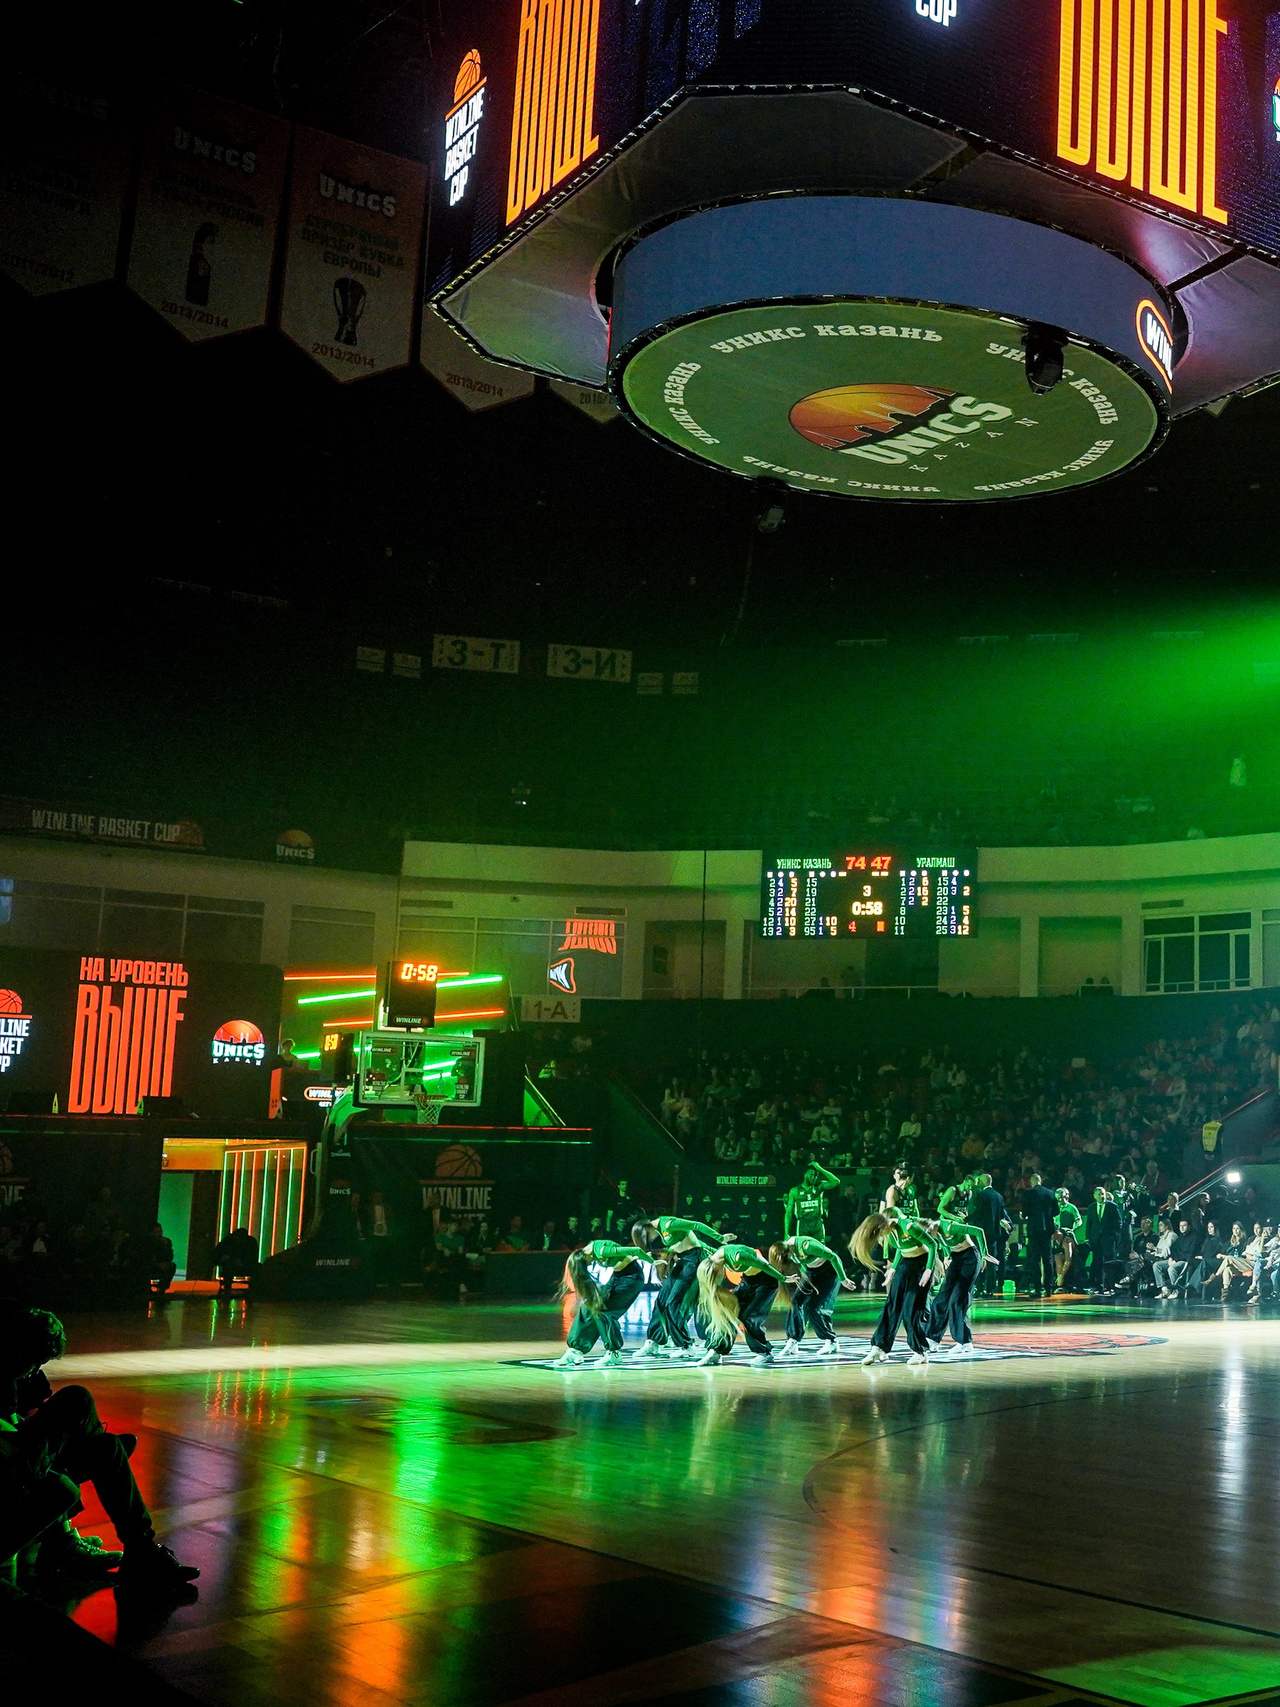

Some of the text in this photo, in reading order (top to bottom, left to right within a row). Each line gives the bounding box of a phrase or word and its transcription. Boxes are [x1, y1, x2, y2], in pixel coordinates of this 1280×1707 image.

[445, 87, 485, 150] WINLINE
[173, 126, 256, 175] UNICS
[444, 123, 479, 181] BASKET
[450, 165, 468, 207] CUP
[318, 173, 396, 219] UNICS
[359, 245, 405, 269] КУБКА
[323, 251, 382, 279] ЕВРОПЫ
[160, 301, 230, 330] 2013/2014
[311, 343, 376, 370] 2013/2014
[445, 373, 504, 399] 2013/2014
[839, 396, 1013, 465] UNICS
[31, 809, 181, 843] WINLINE BASKET CUP
[275, 843, 316, 860] UNICS
[777, 858, 831, 869] УНИКС КАЗАНЬ
[846, 857, 891, 869] 74 47
[916, 857, 955, 868] УРАЛМАШ
[770, 879, 797, 887] 2 4 5
[807, 879, 817, 887] 15
[901, 878, 906, 886] 1
[909, 877, 915, 886] 2
[938, 877, 957, 886] 15 4
[769, 888, 797, 897] 3 2 7
[806, 888, 817, 897] 19
[863, 886, 871, 897] 3
[901, 887, 928, 896] 2 2 16
[937, 887, 970, 896] 20 3 2
[769, 898, 796, 907] 4 2 20
[805, 898, 815, 906] 21
[901, 897, 928, 906] 7 2 2
[937, 897, 948, 906] 22
[768, 908, 796, 916] 5 2 14
[805, 908, 816, 916] 22
[852, 902, 883, 915] 0:58
[936, 906, 970, 915] 23 1 5
[763, 917, 796, 926] 12 1 10
[826, 917, 837, 926] 10
[895, 917, 905, 925] 10
[936, 916, 969, 925] 24 2 4
[763, 927, 795, 936] 13 2 3
[804, 927, 837, 936] 95 1 5
[848, 921, 856, 932] 4
[895, 927, 905, 935] 11
[936, 925, 969, 935] 25 3 12
[79, 956, 189, 987] НА УРОВЕНЬ
[401, 963, 439, 982] 0:58
[68, 984, 188, 1115] ВЫШЕ
[212, 1040, 265, 1059] UNICS
[315, 1258, 351, 1267] WINLINE
